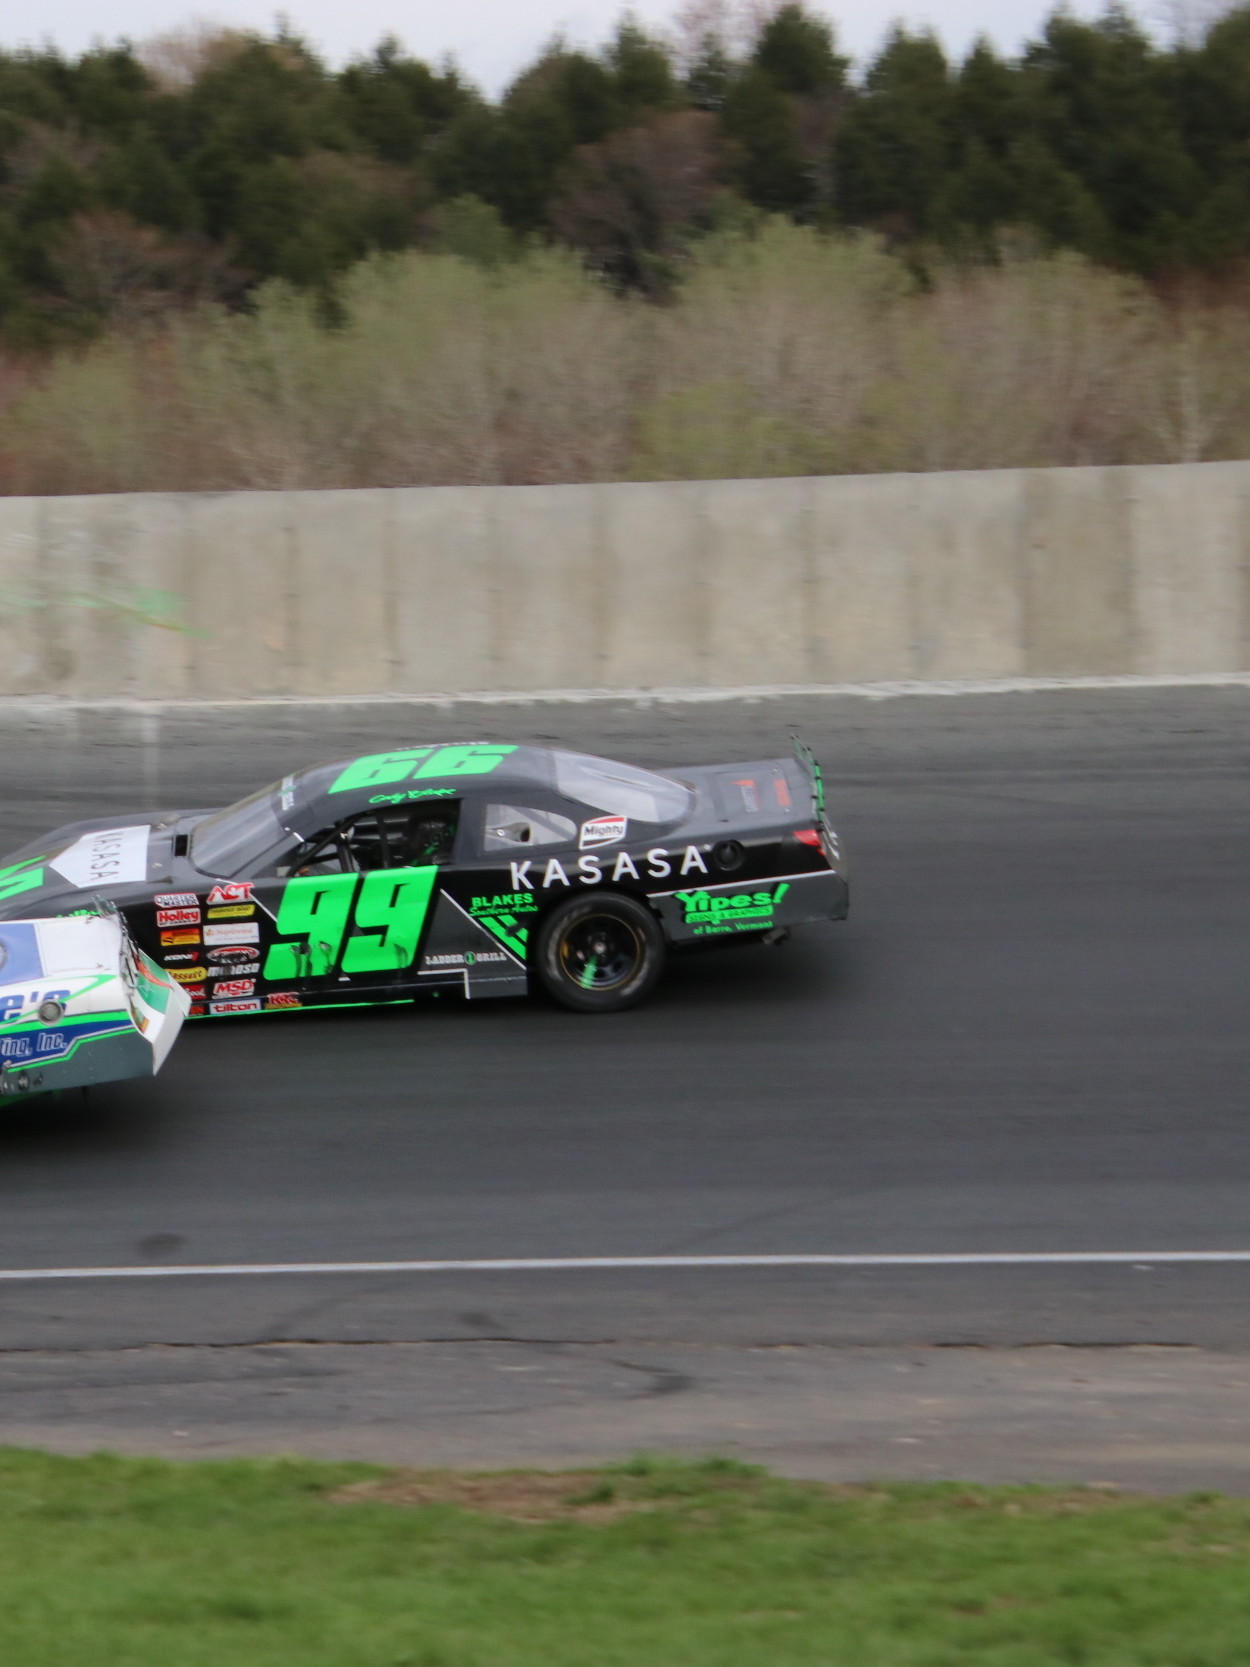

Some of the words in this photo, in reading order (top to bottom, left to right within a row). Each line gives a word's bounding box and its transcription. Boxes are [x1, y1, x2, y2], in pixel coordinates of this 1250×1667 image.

[510, 845, 708, 891] KASASA
[207, 882, 255, 902] ACT
[471, 893, 534, 907] BLAKES
[674, 883, 789, 925] Yipes!
[158, 909, 199, 923] Holley
[263, 865, 439, 981] 99
[425, 954, 465, 965] LADDER
[476, 952, 508, 962] GRILL
[215, 980, 253, 994] MSD
[213, 1002, 257, 1013] tilton
[36, 1032, 68, 1052] Inc.
